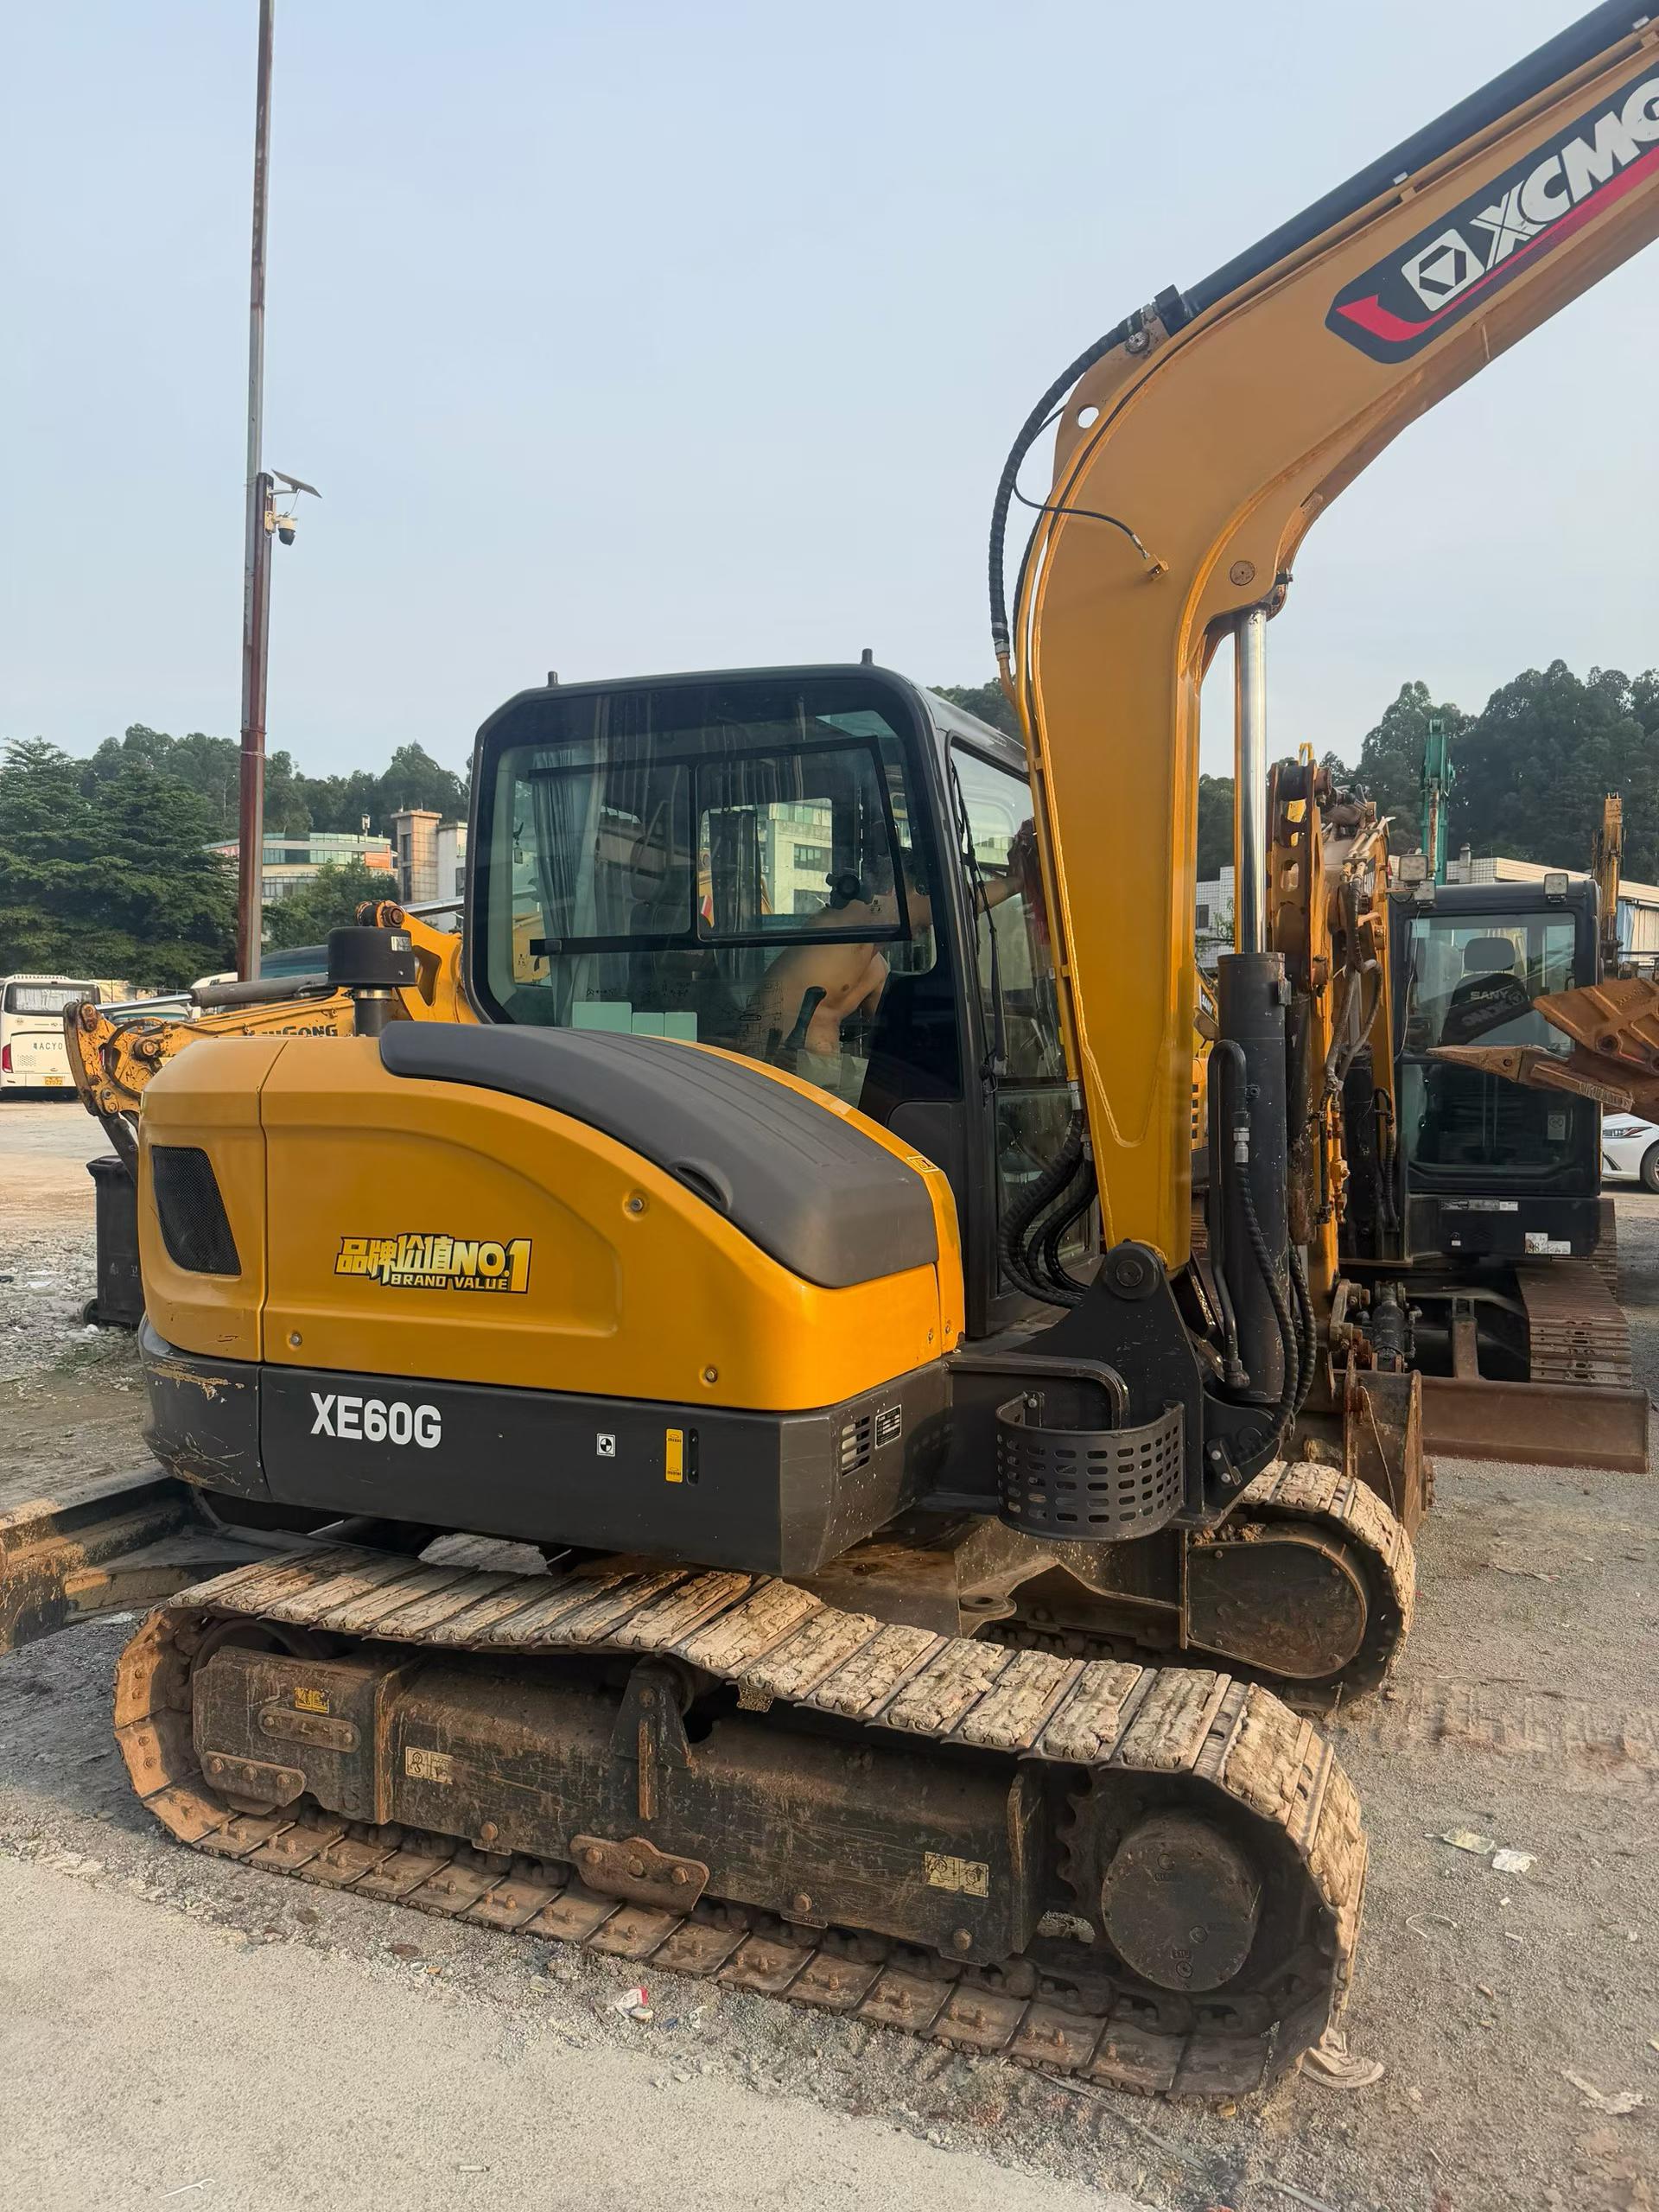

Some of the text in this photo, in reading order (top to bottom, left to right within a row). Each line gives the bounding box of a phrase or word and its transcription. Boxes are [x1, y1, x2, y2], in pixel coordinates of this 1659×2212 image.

[1468, 76, 1659, 271] XCMG
[391, 1274, 508, 1290] BRAND VALUE
[310, 1392, 442, 1449] XE60G
